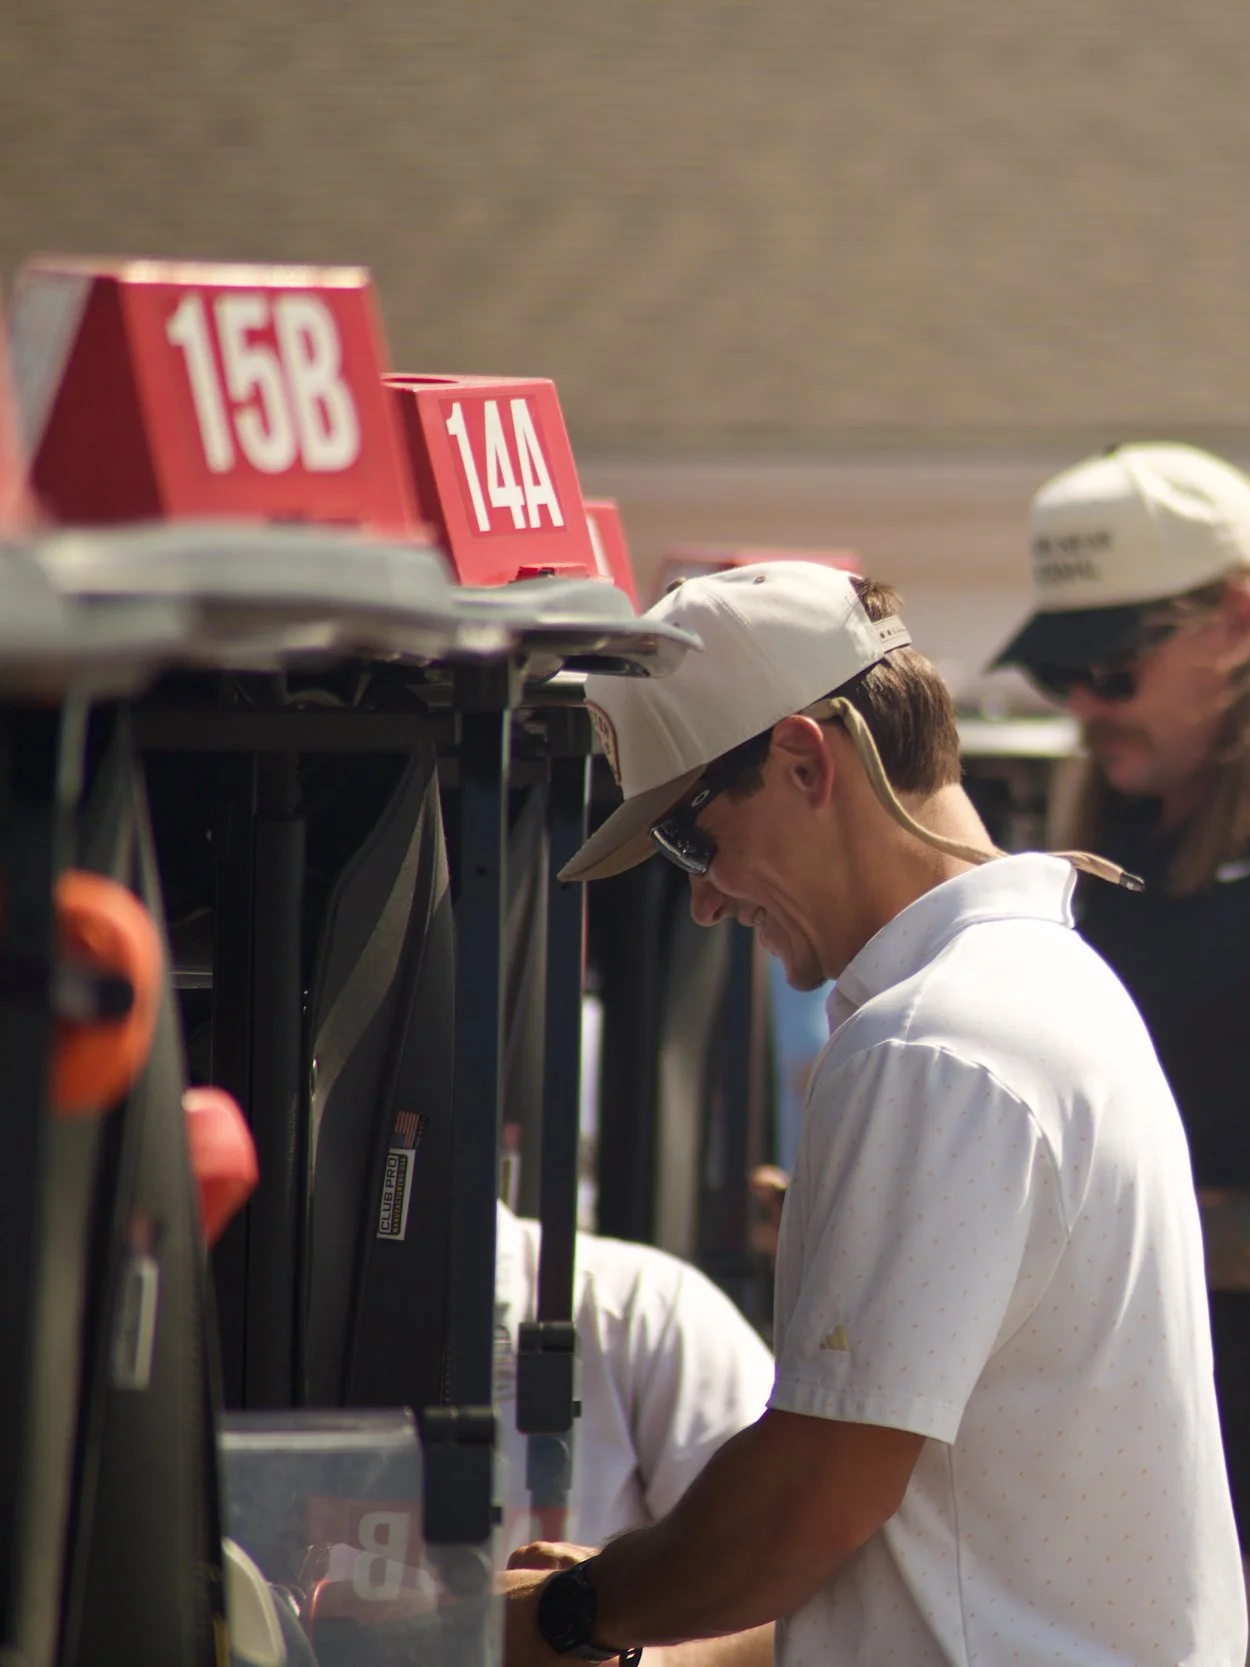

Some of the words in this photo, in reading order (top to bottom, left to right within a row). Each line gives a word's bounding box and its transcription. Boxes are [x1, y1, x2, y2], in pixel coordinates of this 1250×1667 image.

[167, 291, 361, 475] 15B
[446, 398, 564, 532] 14A
[380, 1192, 393, 1230] CLUB
[385, 1157, 397, 1188] PRO
